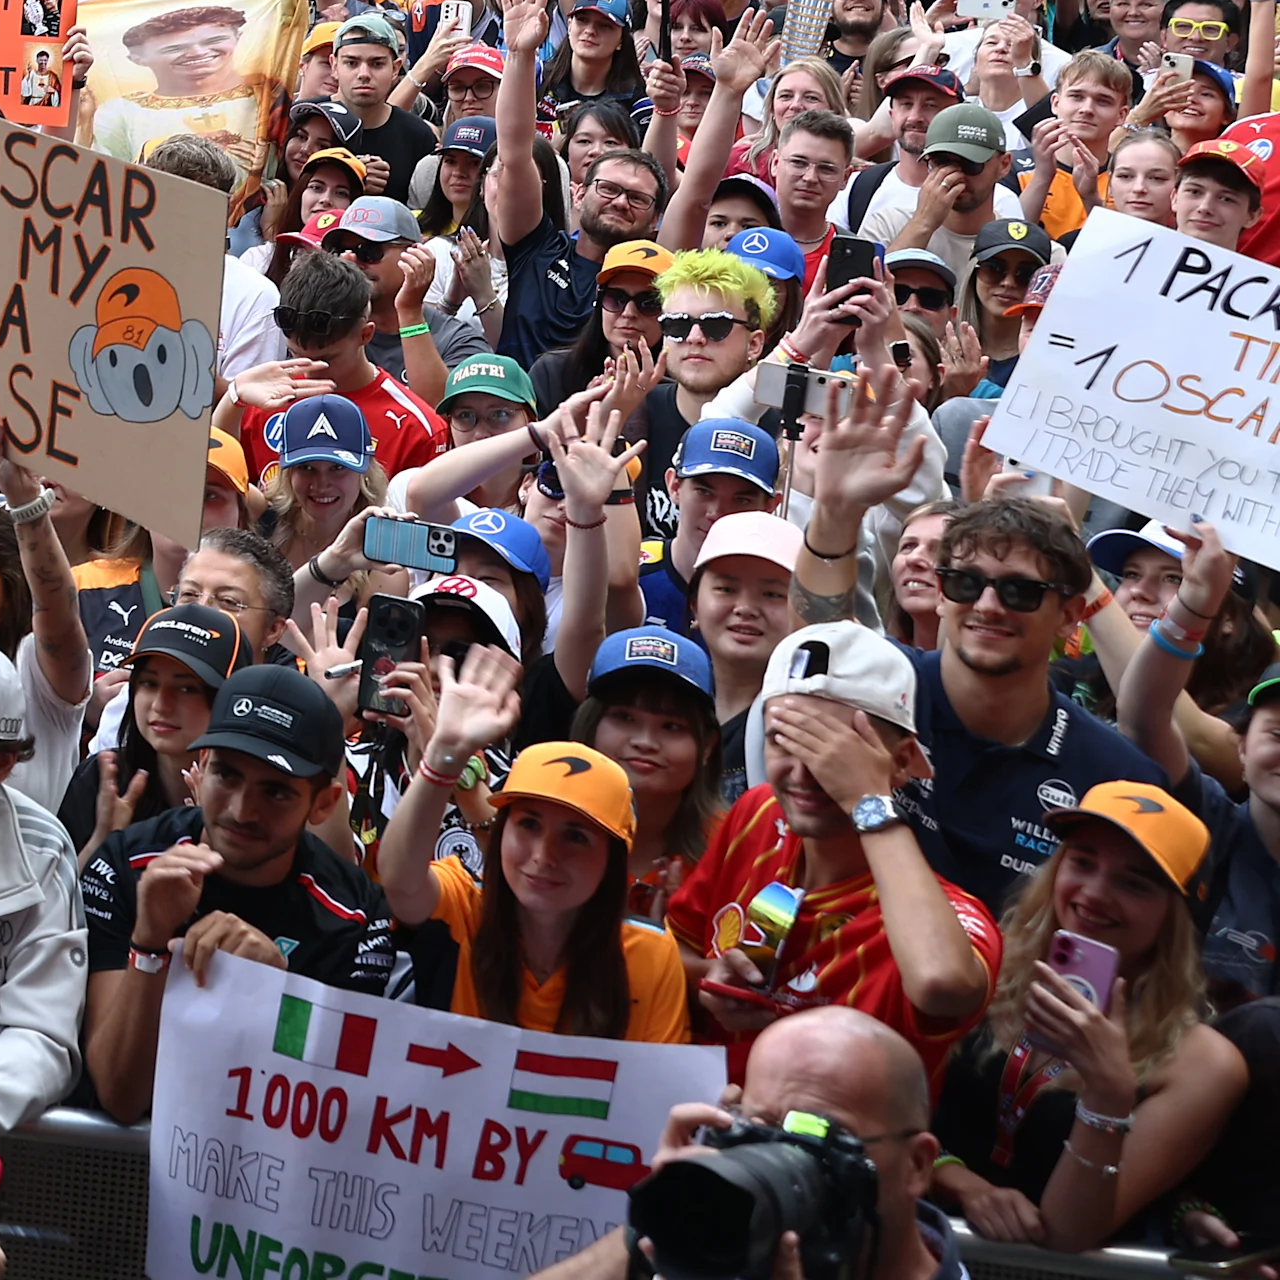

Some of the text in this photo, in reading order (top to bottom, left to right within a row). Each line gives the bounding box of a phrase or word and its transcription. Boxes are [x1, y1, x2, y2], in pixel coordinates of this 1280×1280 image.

[19, 214, 111, 308] MY
[122, 326, 144, 344] 81
[452, 363, 505, 385] PIASTRI
[1045, 396, 1262, 486] BROUGHT YOU
[1042, 430, 1215, 515] TRADE THEM
[150, 620, 211, 640] McLaren
[1046, 708, 1069, 755] umbro
[1040, 788, 1077, 807] Gulf
[90, 858, 117, 884] IWC
[366, 1096, 549, 1186] KM BY
[168, 1126, 400, 1241] MAKE THIS
